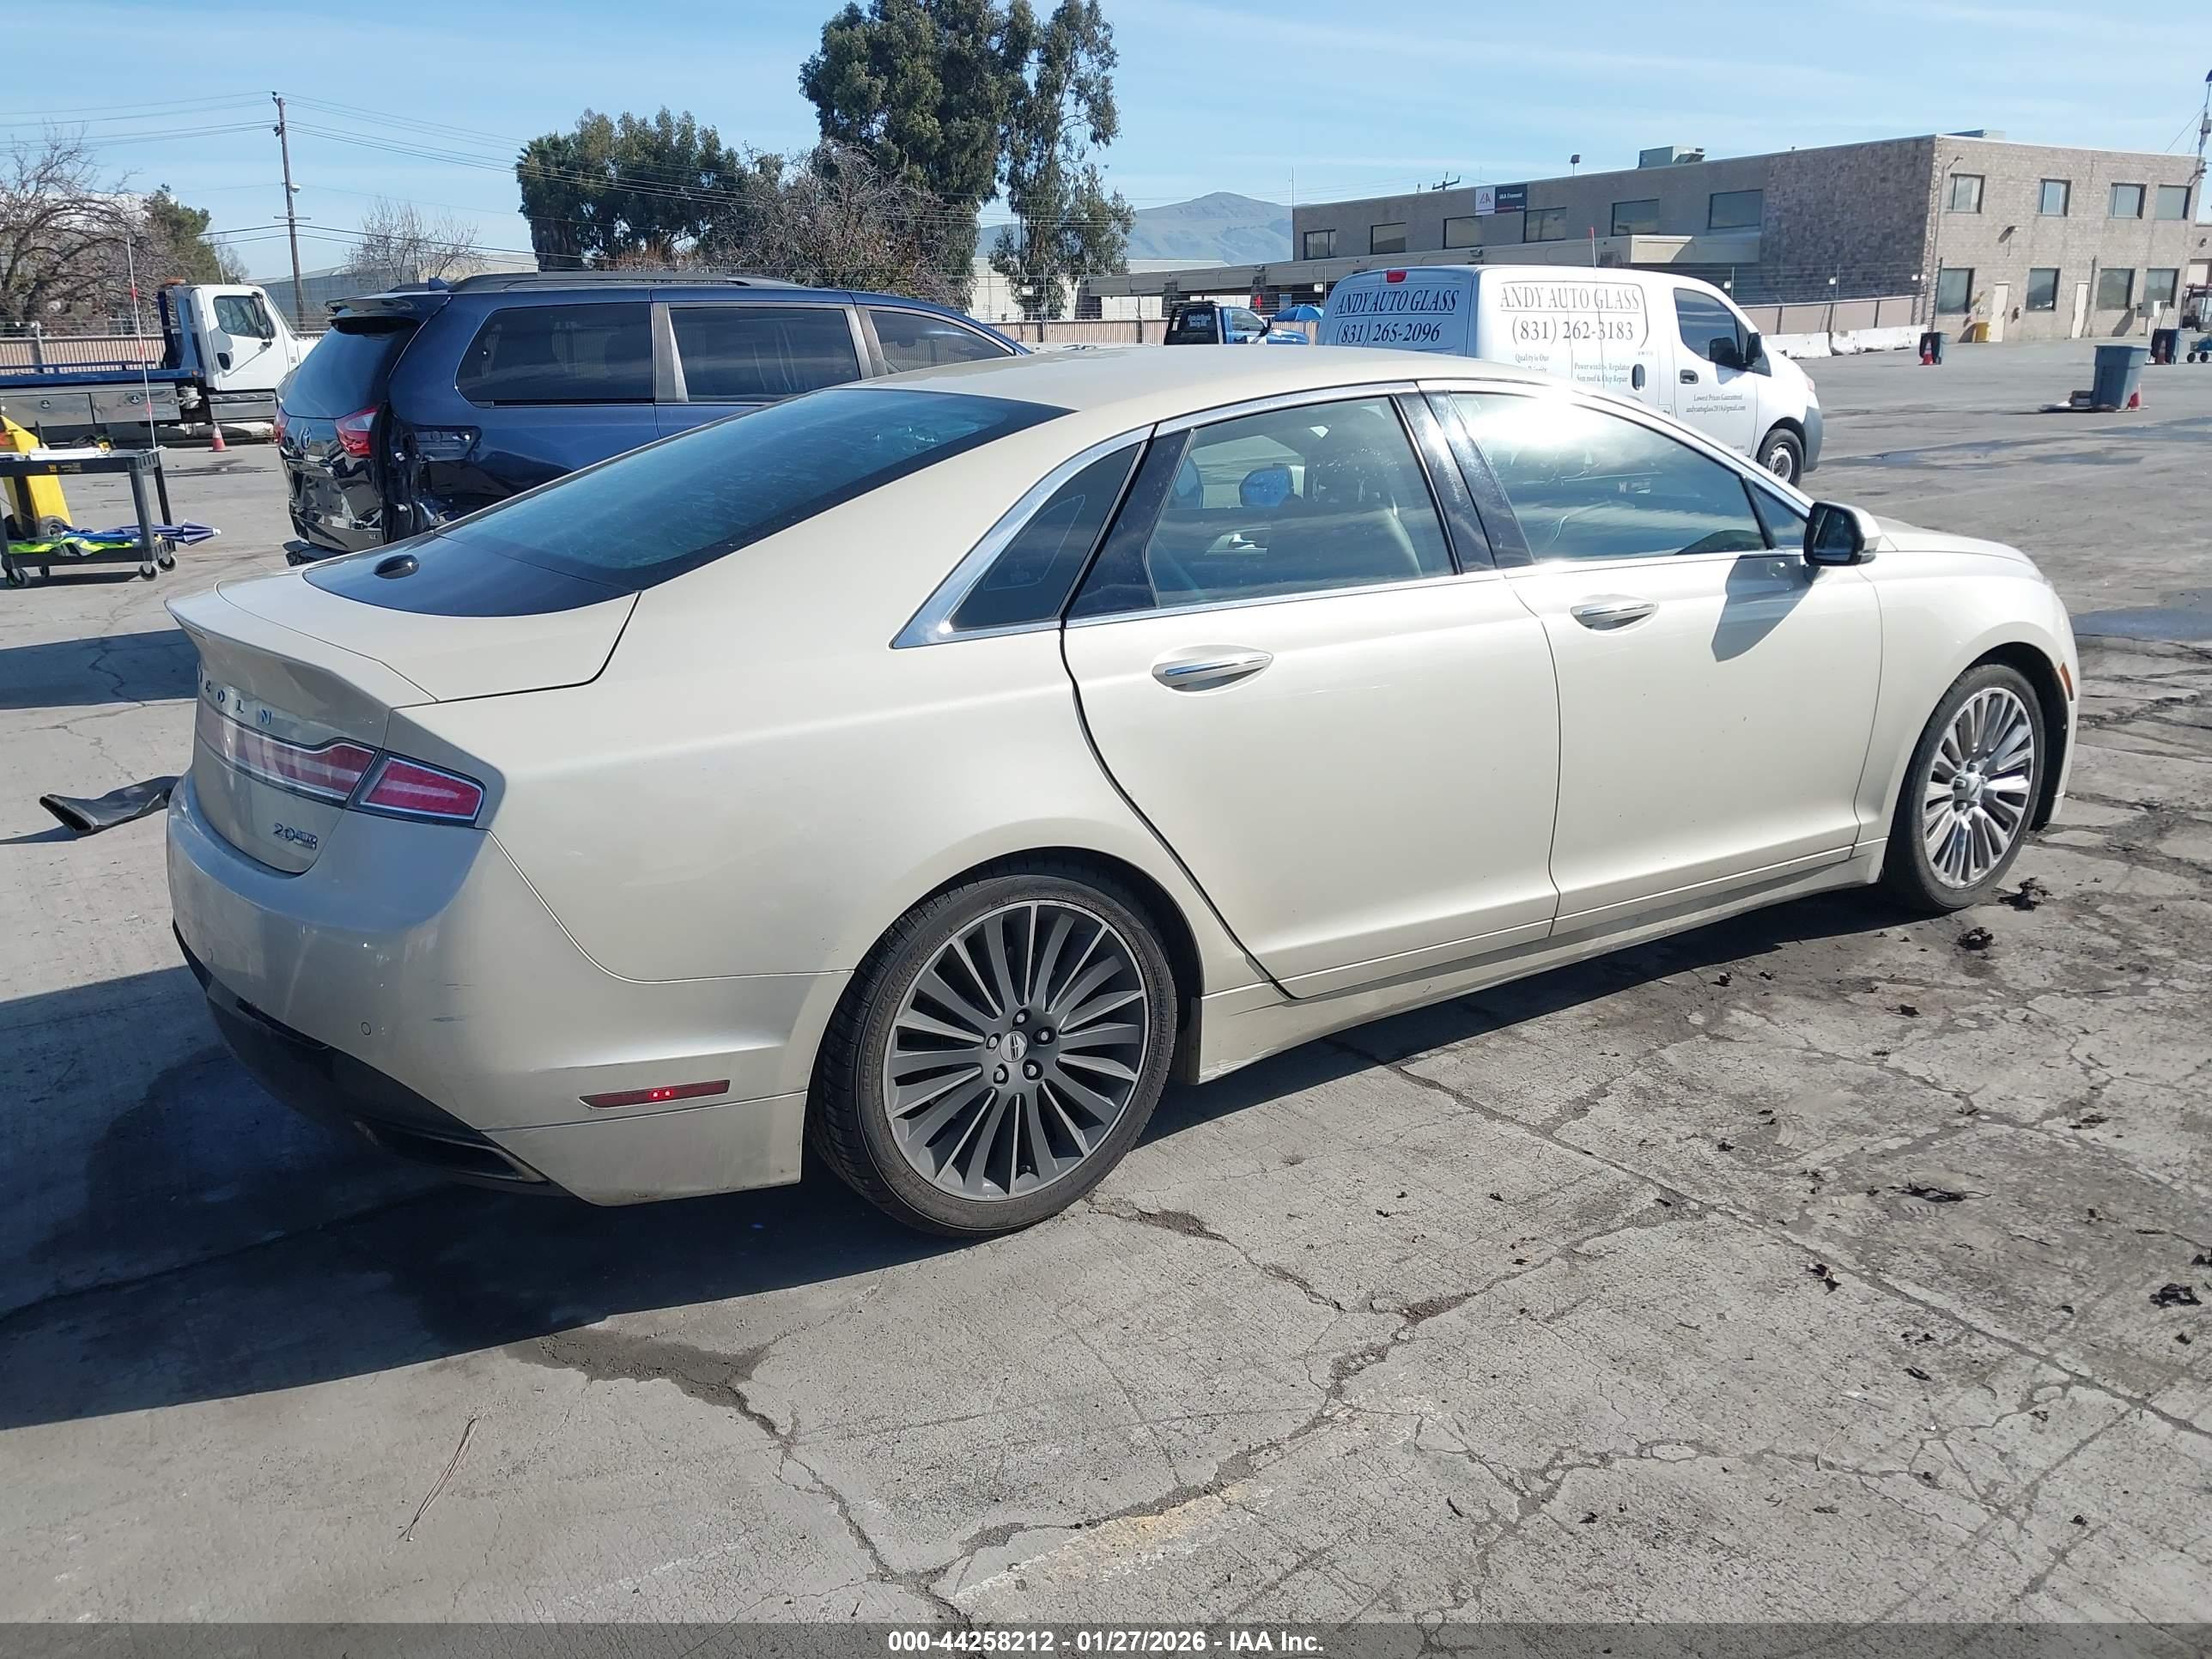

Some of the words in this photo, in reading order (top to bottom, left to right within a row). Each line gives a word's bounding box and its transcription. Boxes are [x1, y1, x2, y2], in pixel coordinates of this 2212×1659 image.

[1334, 291, 1375, 315] ANDY
[1373, 289, 1409, 312] AUTO
[1410, 289, 1460, 312] GLASS
[1500, 286, 1544, 307] ANDY
[1548, 288, 1589, 308] AUTO
[1594, 289, 1639, 310] GLASS
[1336, 319, 1371, 347] (831)
[1372, 322, 1443, 343] 265-2096
[1512, 316, 1557, 344] (831)
[1563, 320, 1633, 341] 262-3183
